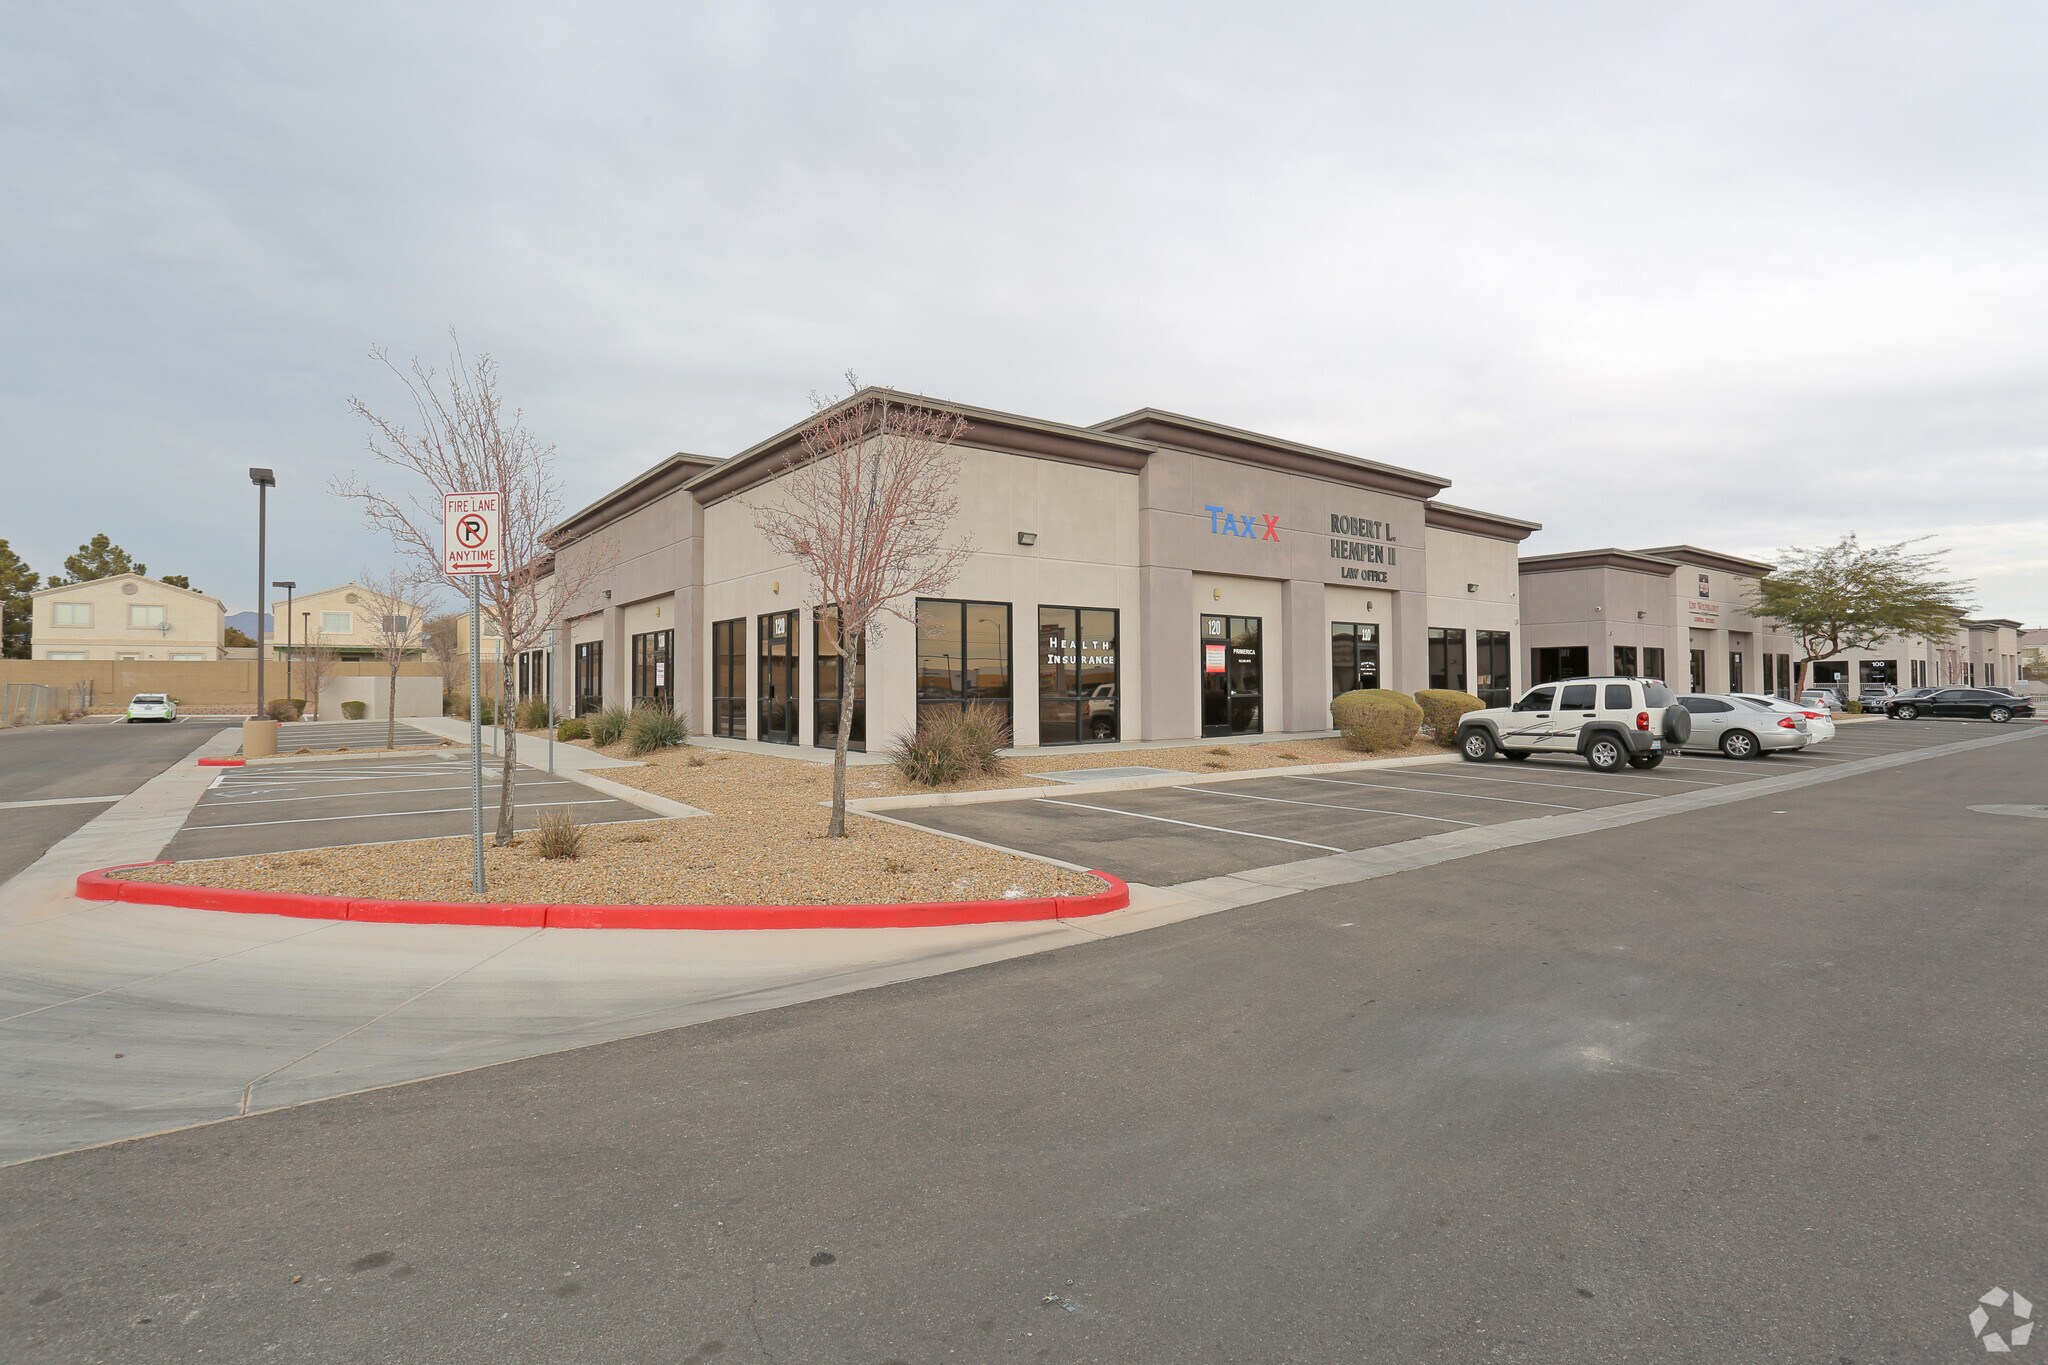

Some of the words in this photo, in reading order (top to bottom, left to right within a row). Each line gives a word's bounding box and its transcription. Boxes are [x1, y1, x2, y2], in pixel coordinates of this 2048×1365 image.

[448, 500, 468, 513] FIRE
[472, 499, 496, 512] LANE
[1262, 513, 1281, 542] X
[1330, 513, 1383, 540] ROBERT
[1385, 523, 1397, 542] L.
[448, 549, 496, 562] ANYTIME
[1330, 538, 1384, 565] HEMPEN
[1387, 547, 1397, 566] II
[1341, 566, 1359, 580] LAW
[1361, 569, 1388, 583] OFFICE
[1208, 619, 1221, 636] 120
[1049, 636, 1109, 650] HEALTH
[1047, 653, 1115, 665] INSURANCE
